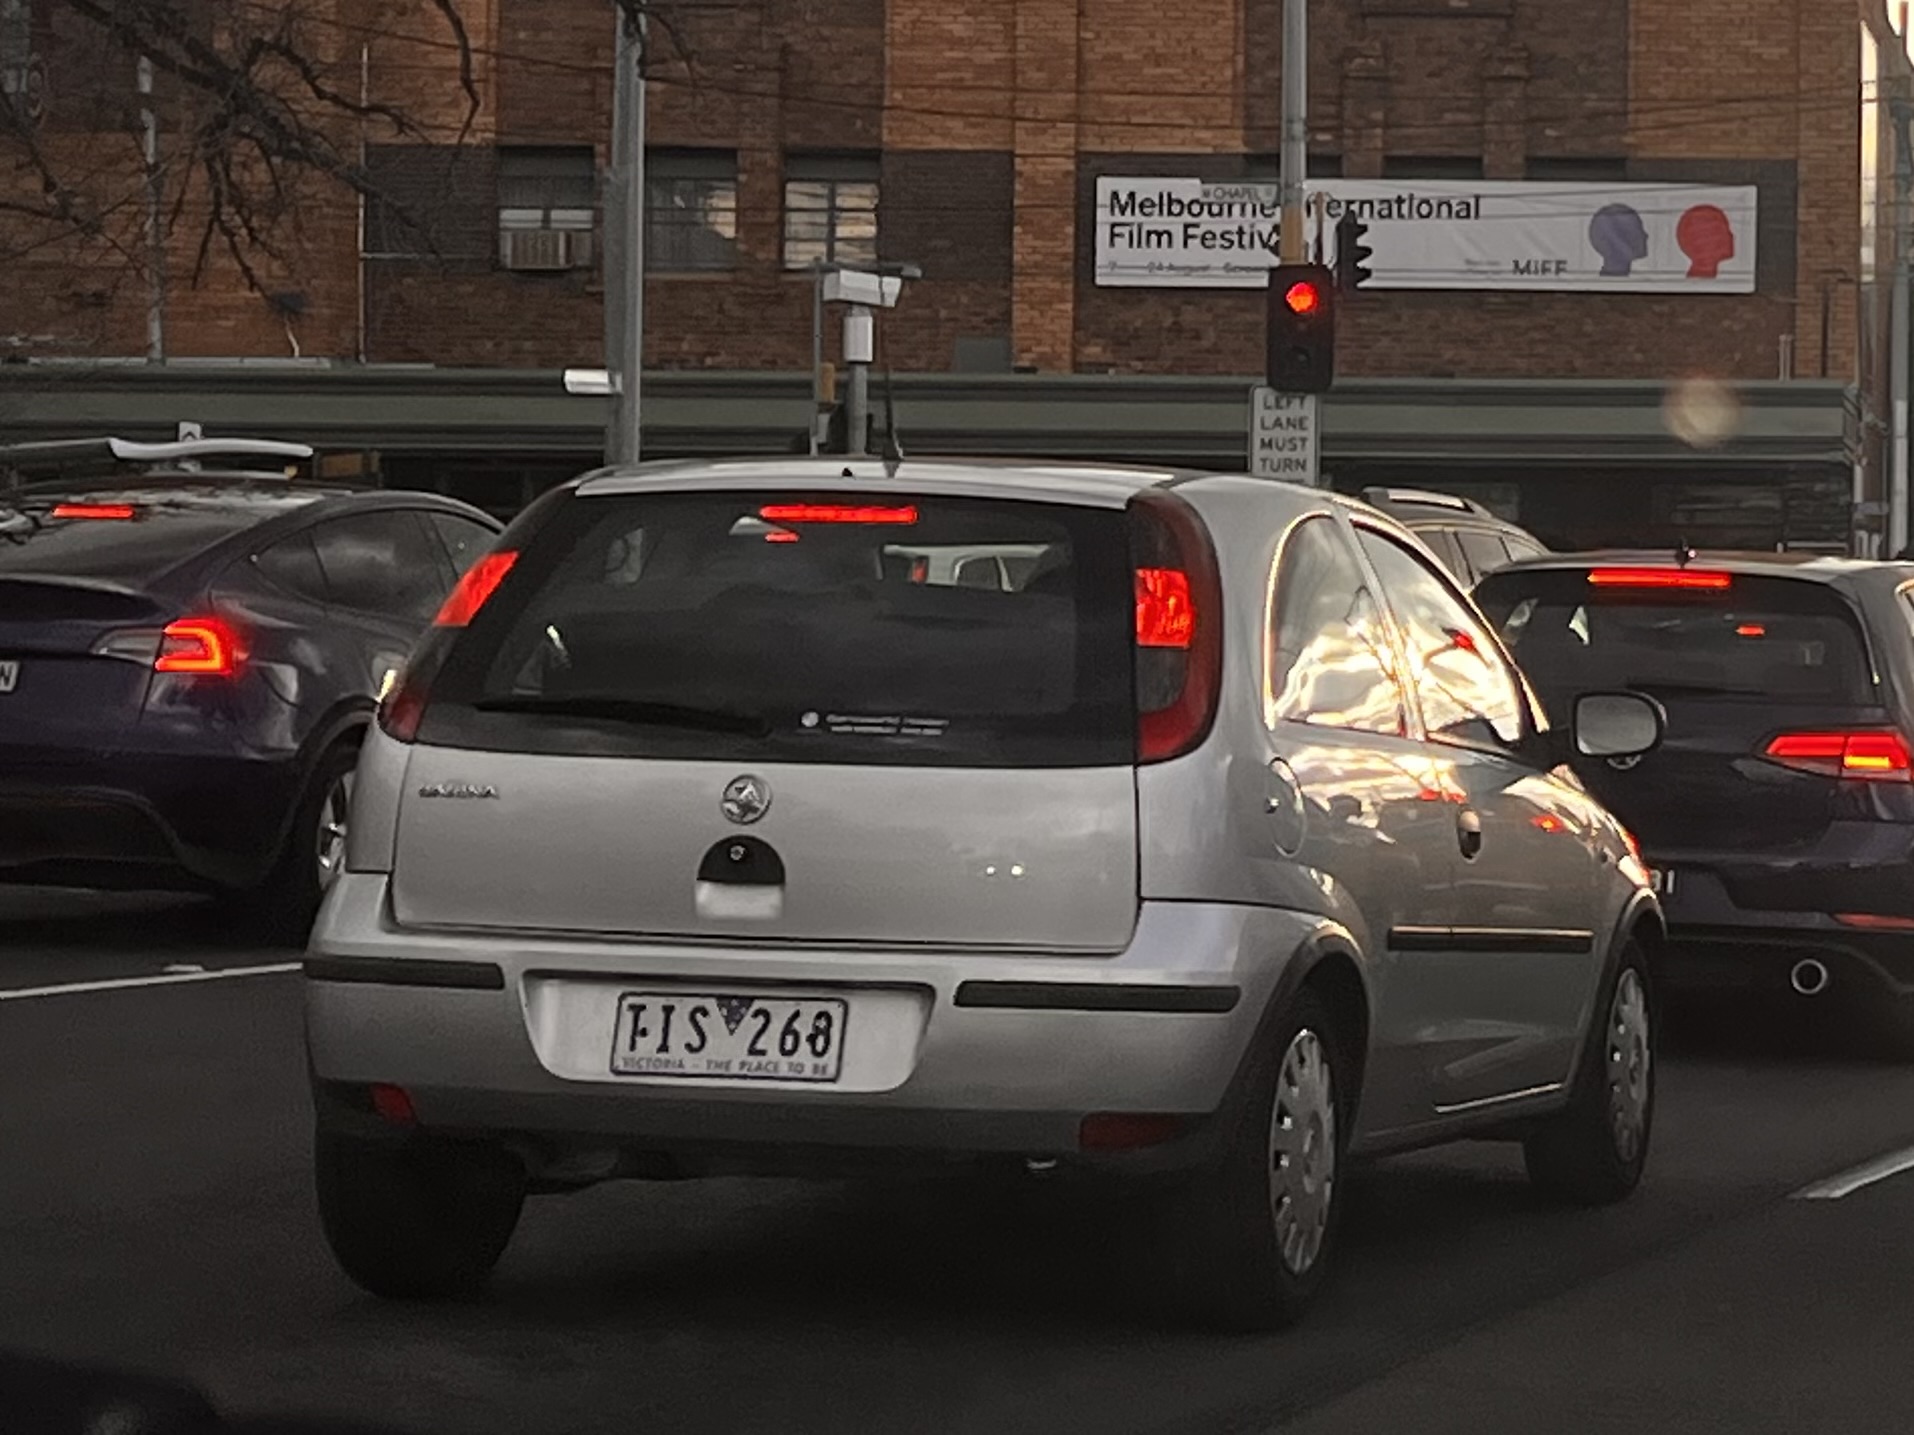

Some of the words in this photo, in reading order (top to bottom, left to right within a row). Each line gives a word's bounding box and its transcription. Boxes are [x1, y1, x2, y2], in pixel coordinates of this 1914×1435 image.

[1110, 191, 1275, 218] Melbourne
[1306, 194, 1481, 219] ernational
[1109, 222, 1173, 249] Film
[1183, 222, 1275, 249] Festiv
[1512, 259, 1567, 275] MIFF
[1263, 394, 1307, 410] LEFT
[1260, 416, 1309, 431] LANE
[1260, 437, 1308, 452] MUST
[1260, 457, 1307, 472] TURN
[622, 1057, 685, 1070] VICTORIA
[706, 1059, 731, 1072] THE
[739, 1061, 779, 1073] PLACE
[787, 1062, 804, 1074] TO
